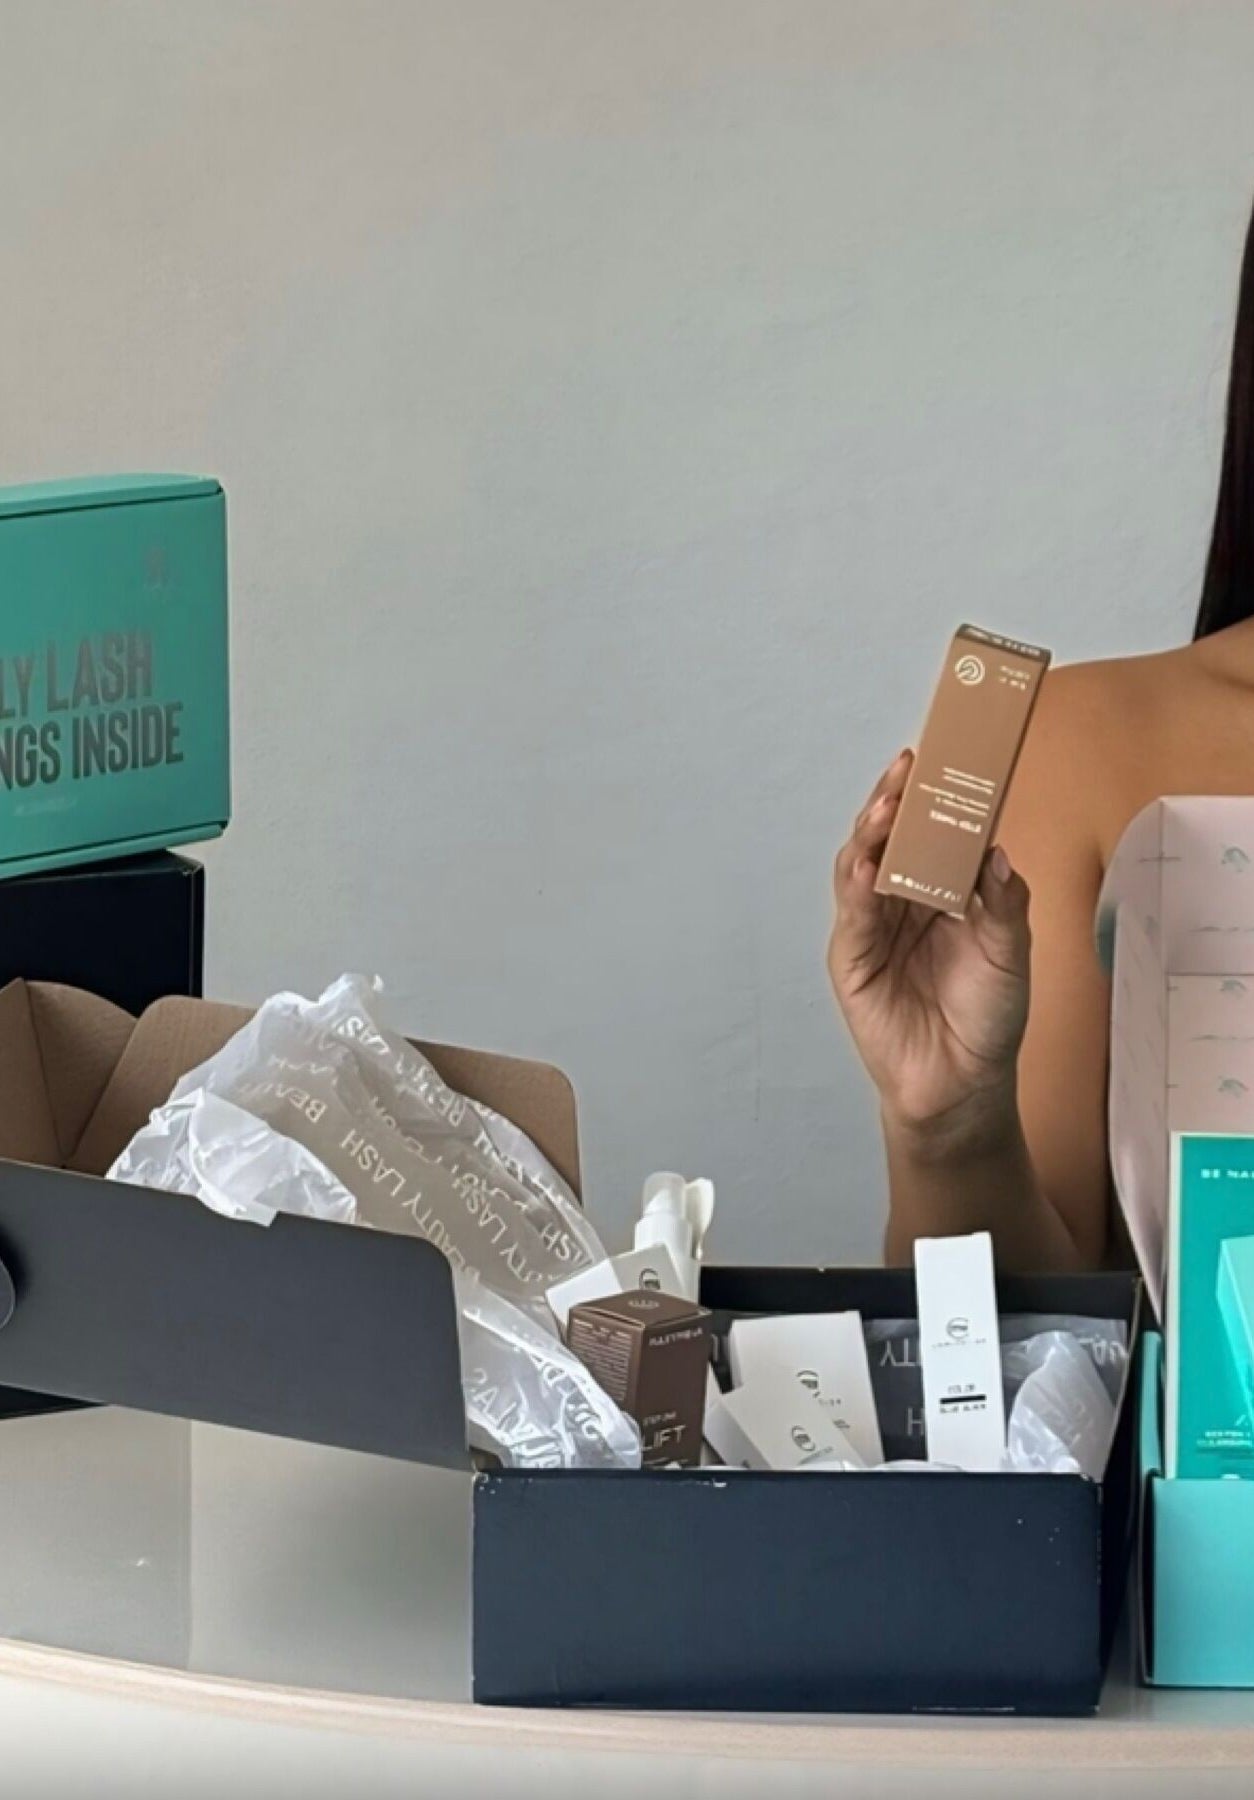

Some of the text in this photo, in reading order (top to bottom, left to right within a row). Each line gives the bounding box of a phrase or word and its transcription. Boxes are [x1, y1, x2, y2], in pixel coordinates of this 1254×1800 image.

[47, 632, 154, 712] LASH
[72, 702, 184, 779] INSIDE
[339, 1128, 407, 1196] LASH
